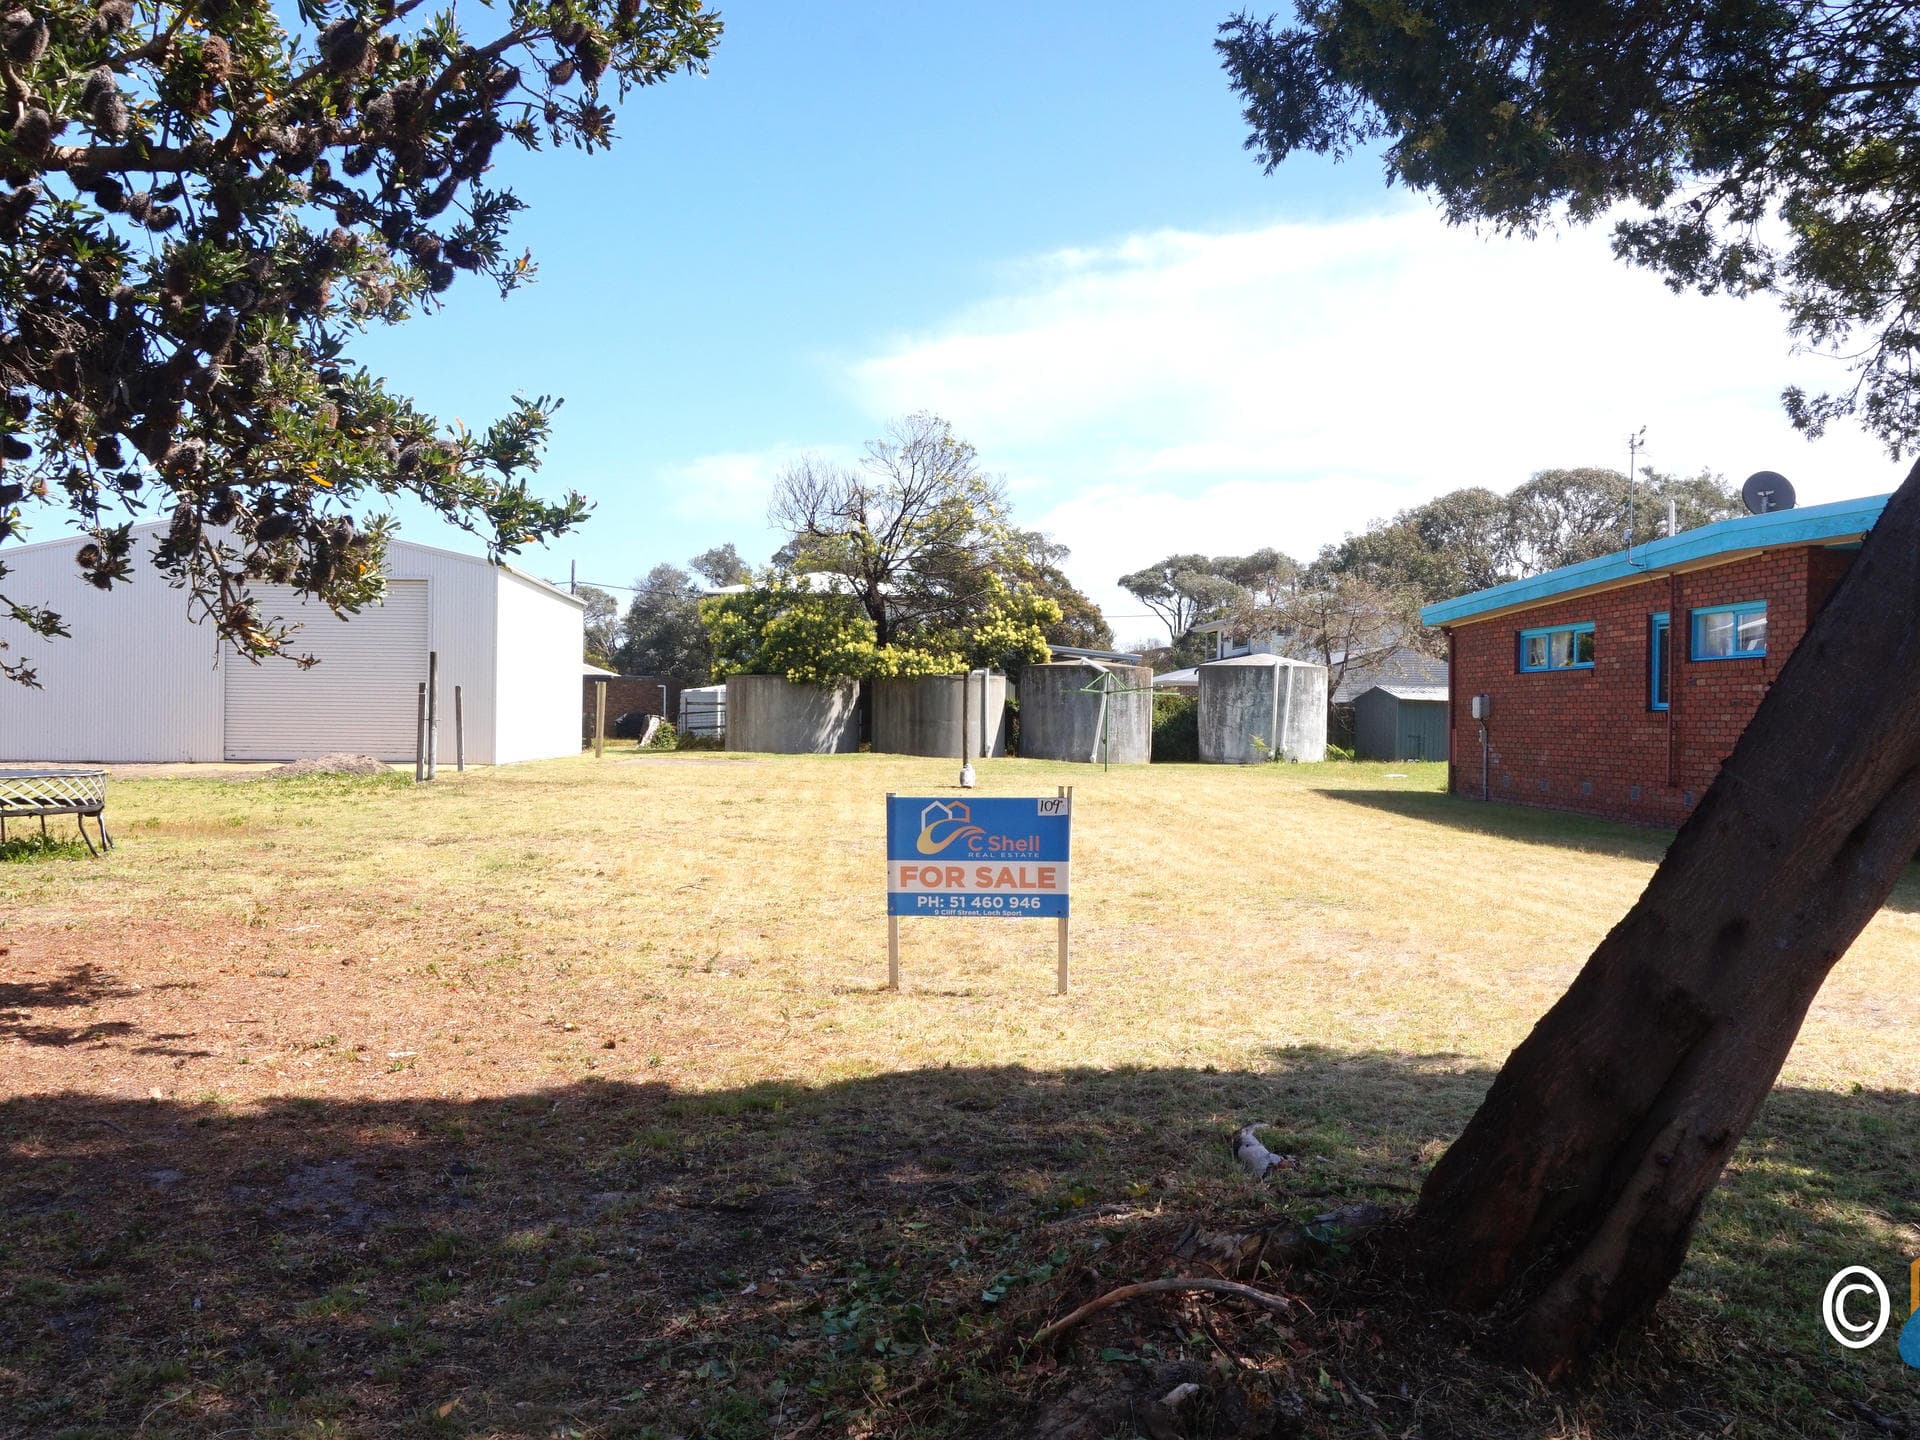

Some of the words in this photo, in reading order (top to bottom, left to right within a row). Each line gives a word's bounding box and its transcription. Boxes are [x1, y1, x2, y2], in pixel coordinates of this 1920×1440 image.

[967, 835, 983, 851] C
[988, 834, 1040, 851] Shell
[900, 865, 965, 888] FOR
[975, 866, 1057, 889] SALE
[917, 896, 944, 908] PH:
[949, 896, 965, 908] 51
[970, 896, 1004, 908] 460
[1009, 897, 1041, 909] 946
